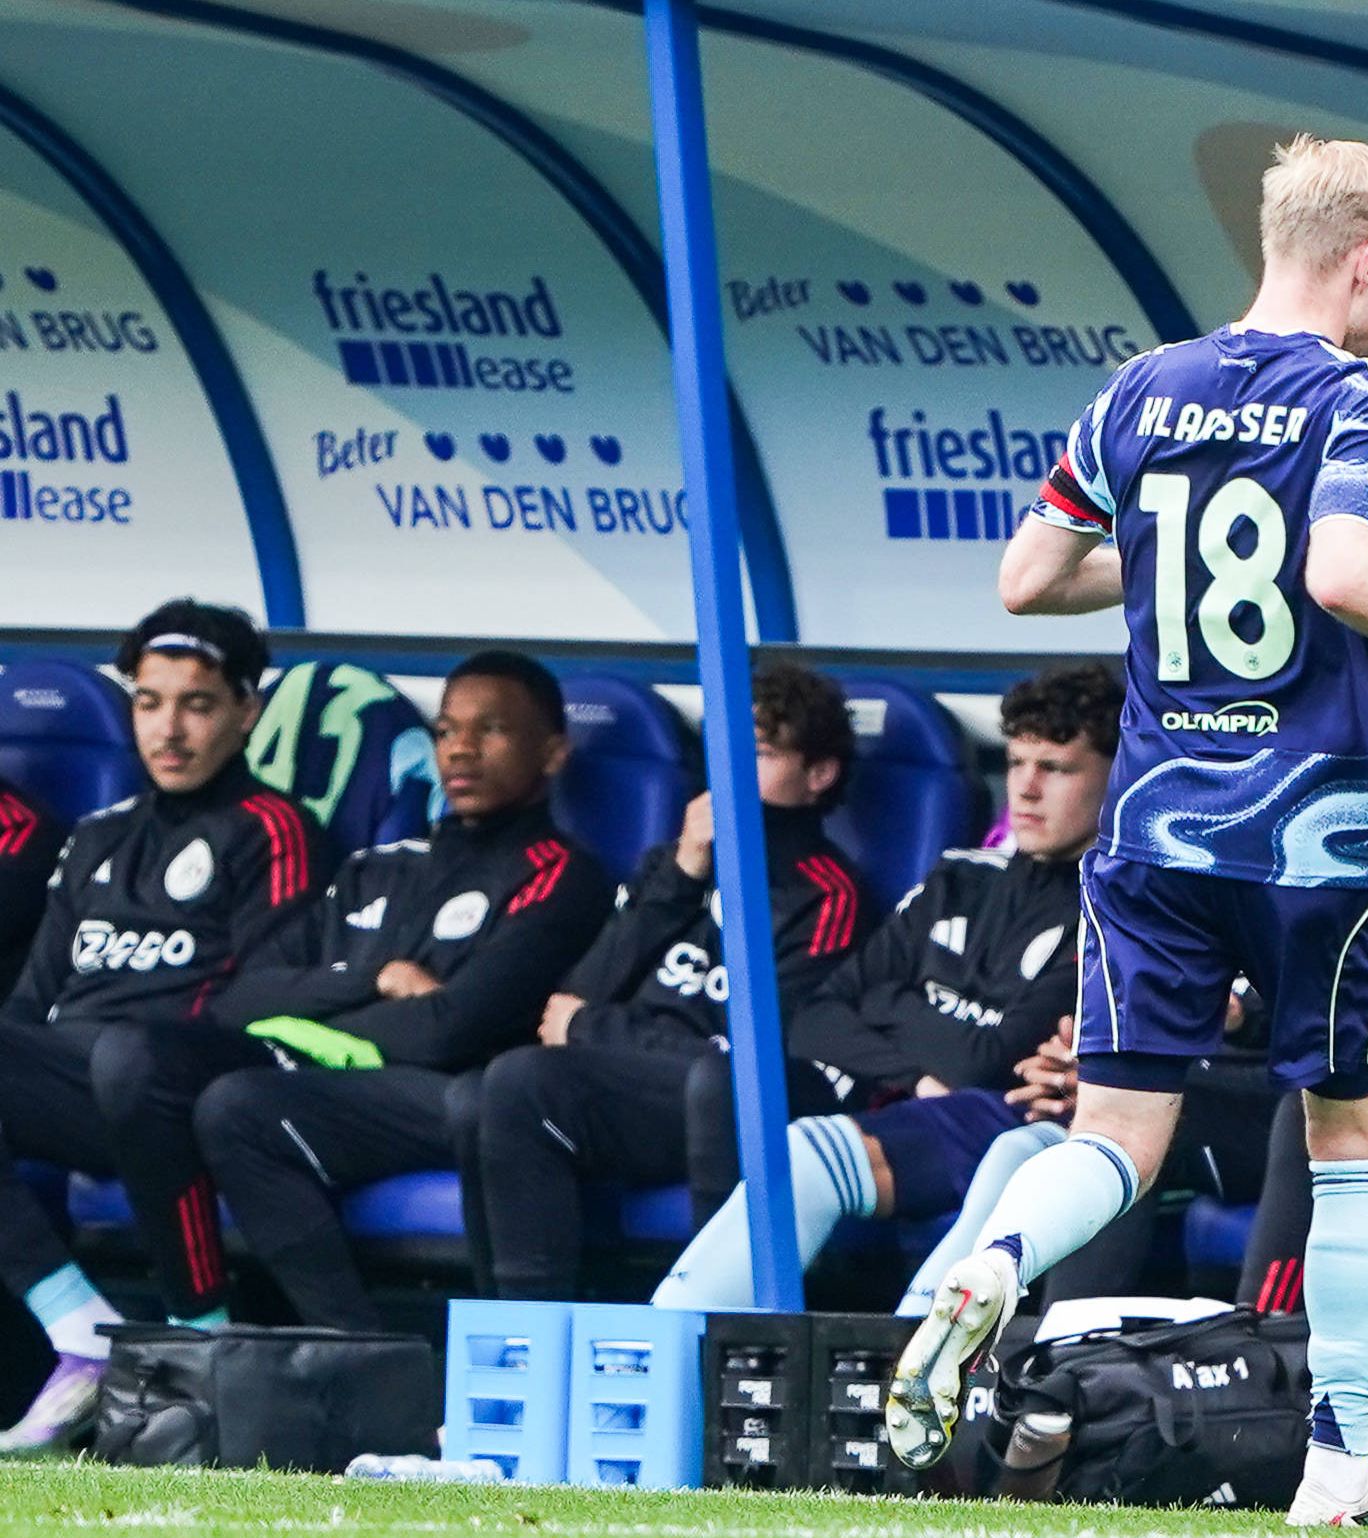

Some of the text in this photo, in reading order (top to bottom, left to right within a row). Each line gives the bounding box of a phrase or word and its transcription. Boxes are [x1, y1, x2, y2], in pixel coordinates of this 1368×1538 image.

[313, 269, 563, 337] friesland
[725, 276, 812, 322] Beter
[30, 310, 160, 352] BRUG
[798, 322, 1139, 368] VAN DEN BRUG
[312, 427, 400, 479] Beter
[868, 406, 1069, 481] frieslan
[376, 483, 473, 530] VAN
[481, 485, 579, 533] DEN
[1138, 473, 1295, 682] 18
[243, 661, 397, 830] 43
[1161, 709, 1279, 734] OLYMPIA
[1171, 1360, 1231, 1390] Aax
